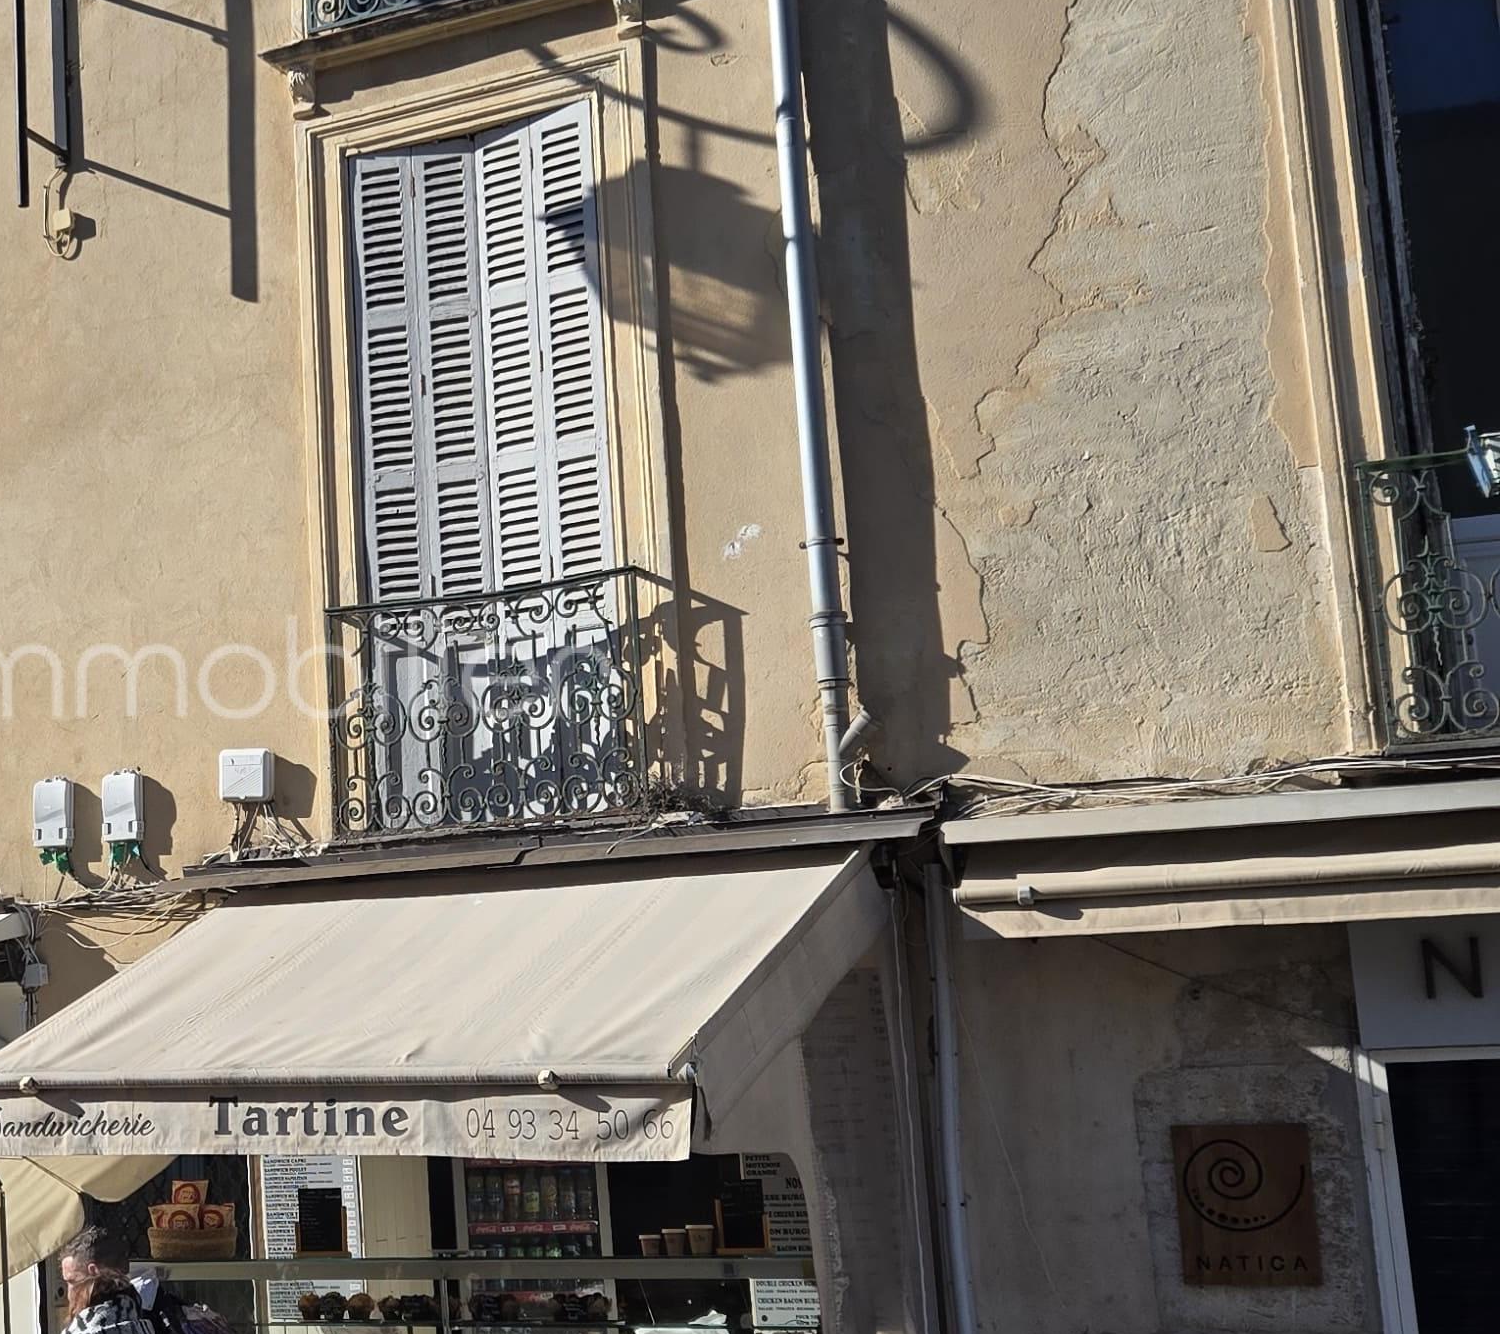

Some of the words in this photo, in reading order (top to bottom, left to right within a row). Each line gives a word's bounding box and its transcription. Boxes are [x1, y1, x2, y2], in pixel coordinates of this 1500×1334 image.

[209, 1096, 410, 1138] Tartine
[466, 1108, 497, 1140] 04
[507, 1108, 537, 1140] 93
[548, 1109, 580, 1141] 34
[596, 1109, 630, 1141] 50
[643, 1108, 675, 1140] 66
